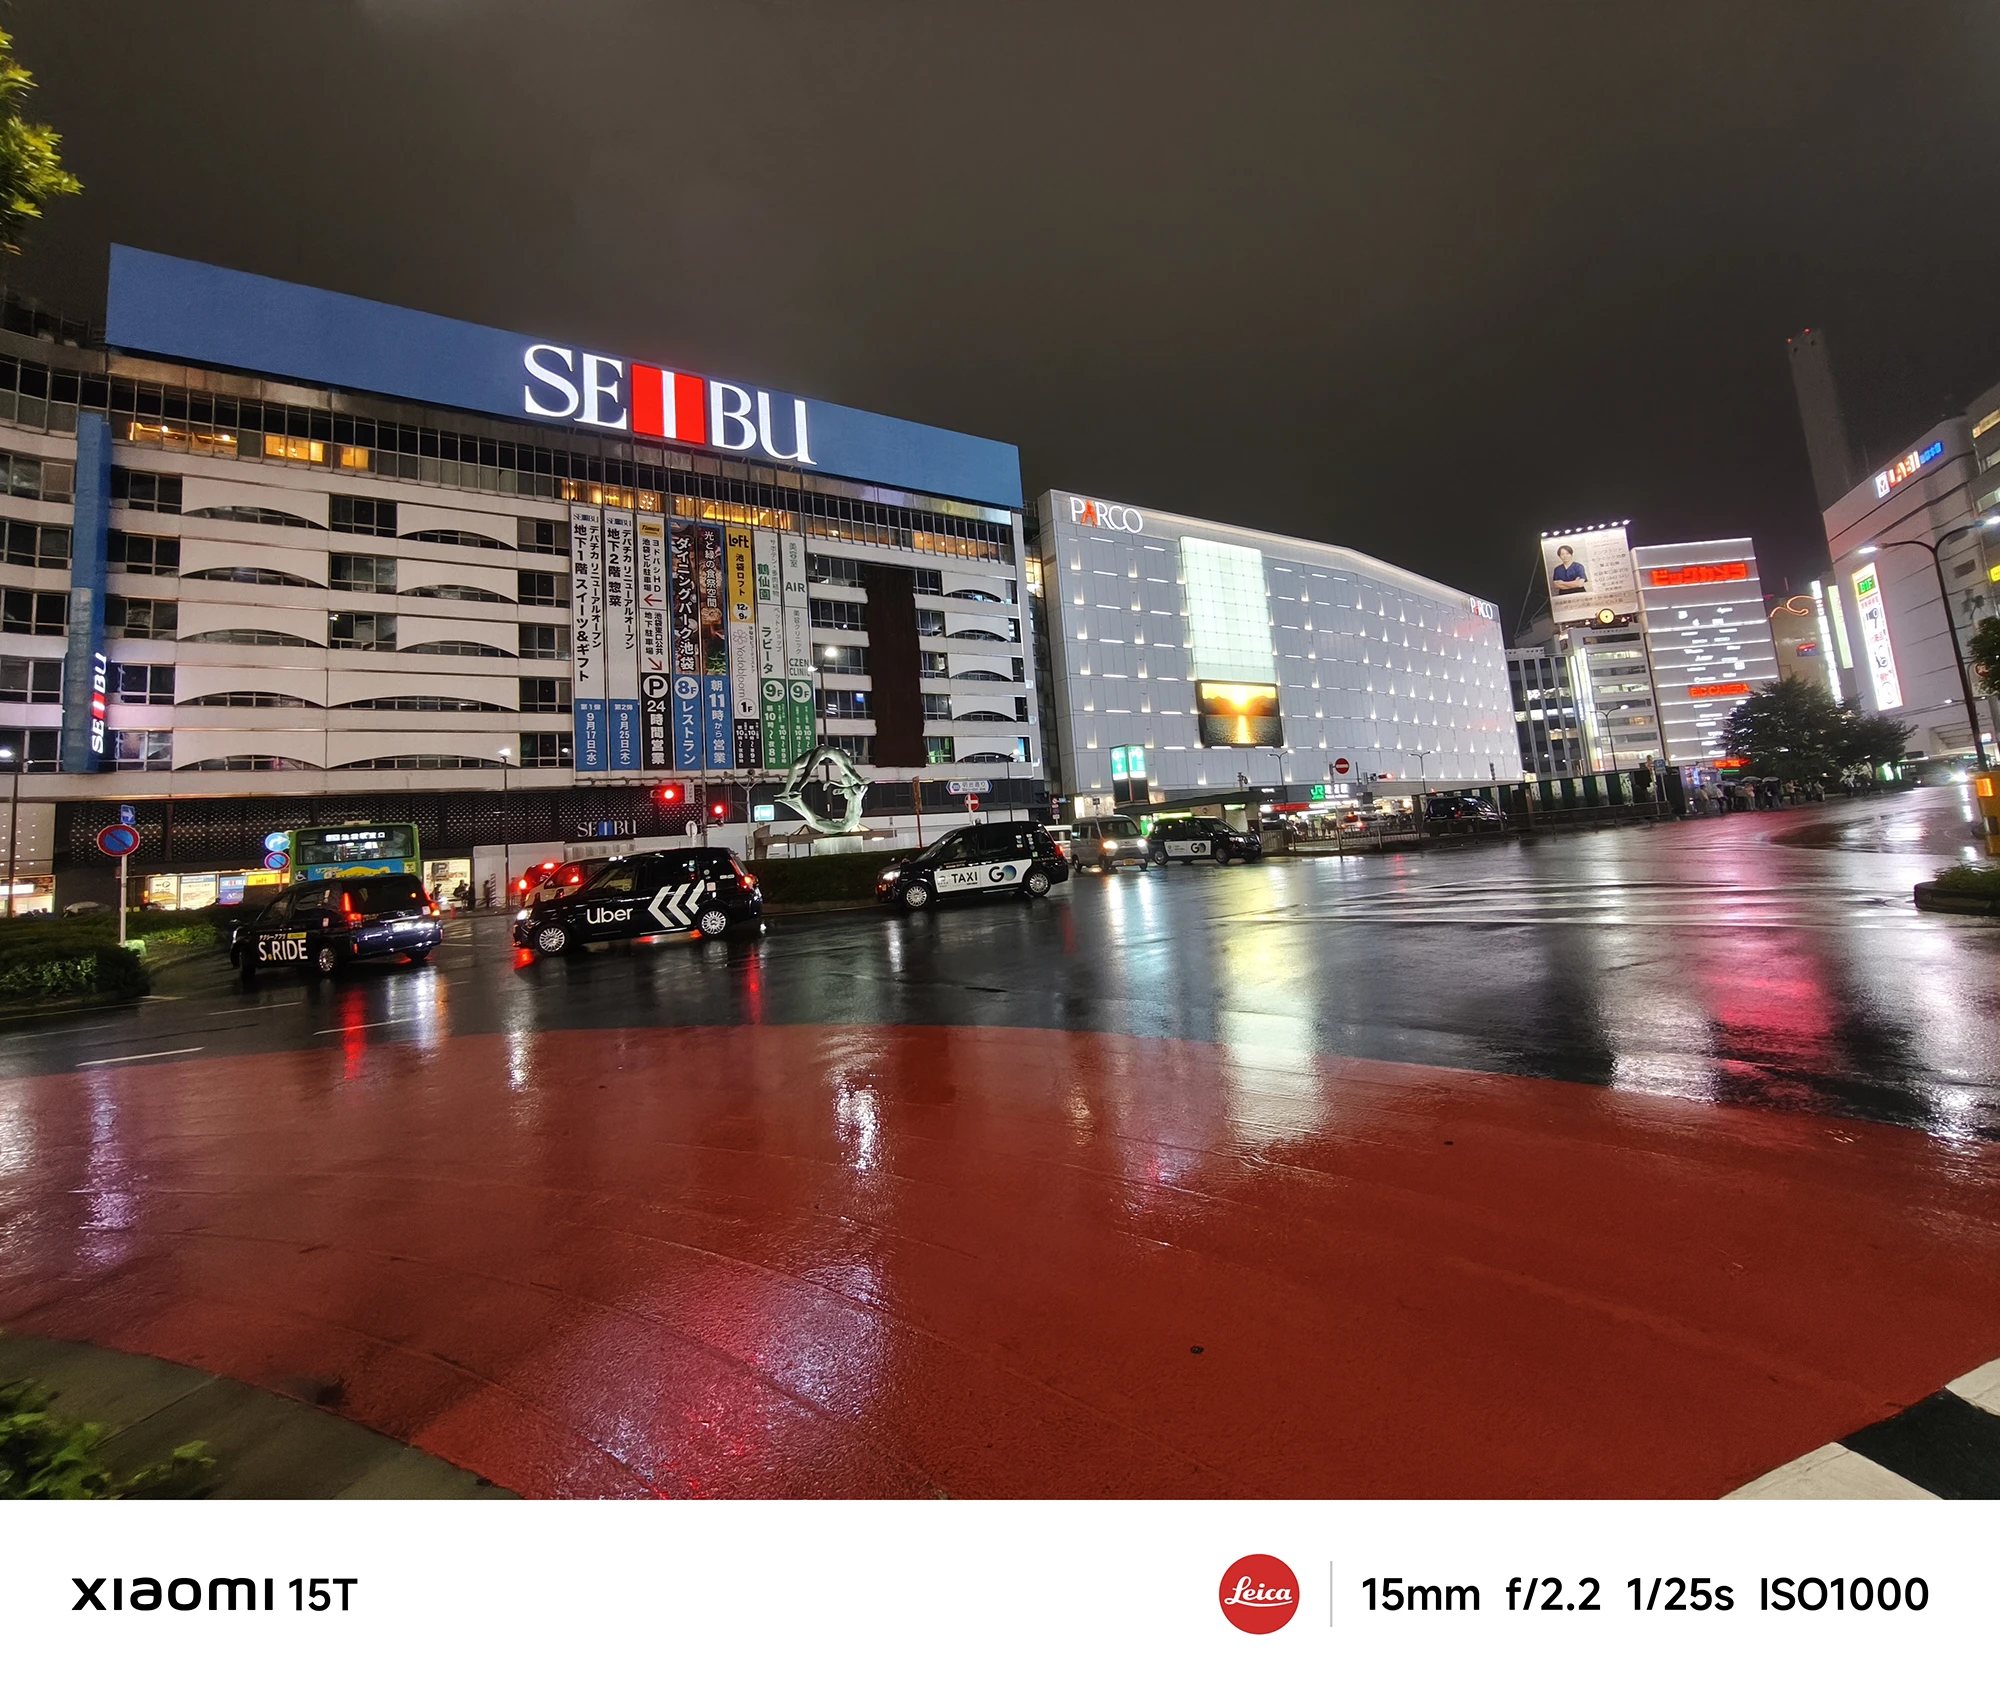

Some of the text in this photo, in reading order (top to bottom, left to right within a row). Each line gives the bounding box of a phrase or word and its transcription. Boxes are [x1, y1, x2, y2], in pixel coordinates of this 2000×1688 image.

[524, 344, 818, 466] SEIBU
[1070, 496, 1143, 534] PARCO
[607, 528, 621, 606] 地下2階 惣菜
[590, 525, 602, 648] デパチカ リニューアルオープン
[622, 530, 634, 649] デパチカ リニューアルオープン
[785, 582, 805, 593] AIR
[574, 524, 590, 682] 地下1階 スイーツ&ギフト
[676, 538, 695, 670] ダイニングパーク池袋
[762, 626, 773, 674] ラビータ
[649, 678, 664, 696] P
[678, 680, 697, 695] 8F
[766, 684, 783, 697] 9F
[793, 685, 810, 698] 9F
[92, 652, 107, 754] SEIBU
[741, 702, 753, 712] 1F
[682, 702, 696, 765] レストラン
[1311, 784, 1324, 794] JR
[578, 819, 637, 838] SEIBU
[951, 871, 978, 884] TAXI
[989, 865, 1017, 882] GO
[587, 908, 633, 925] Uber
[259, 940, 308, 961] S.RIDE
